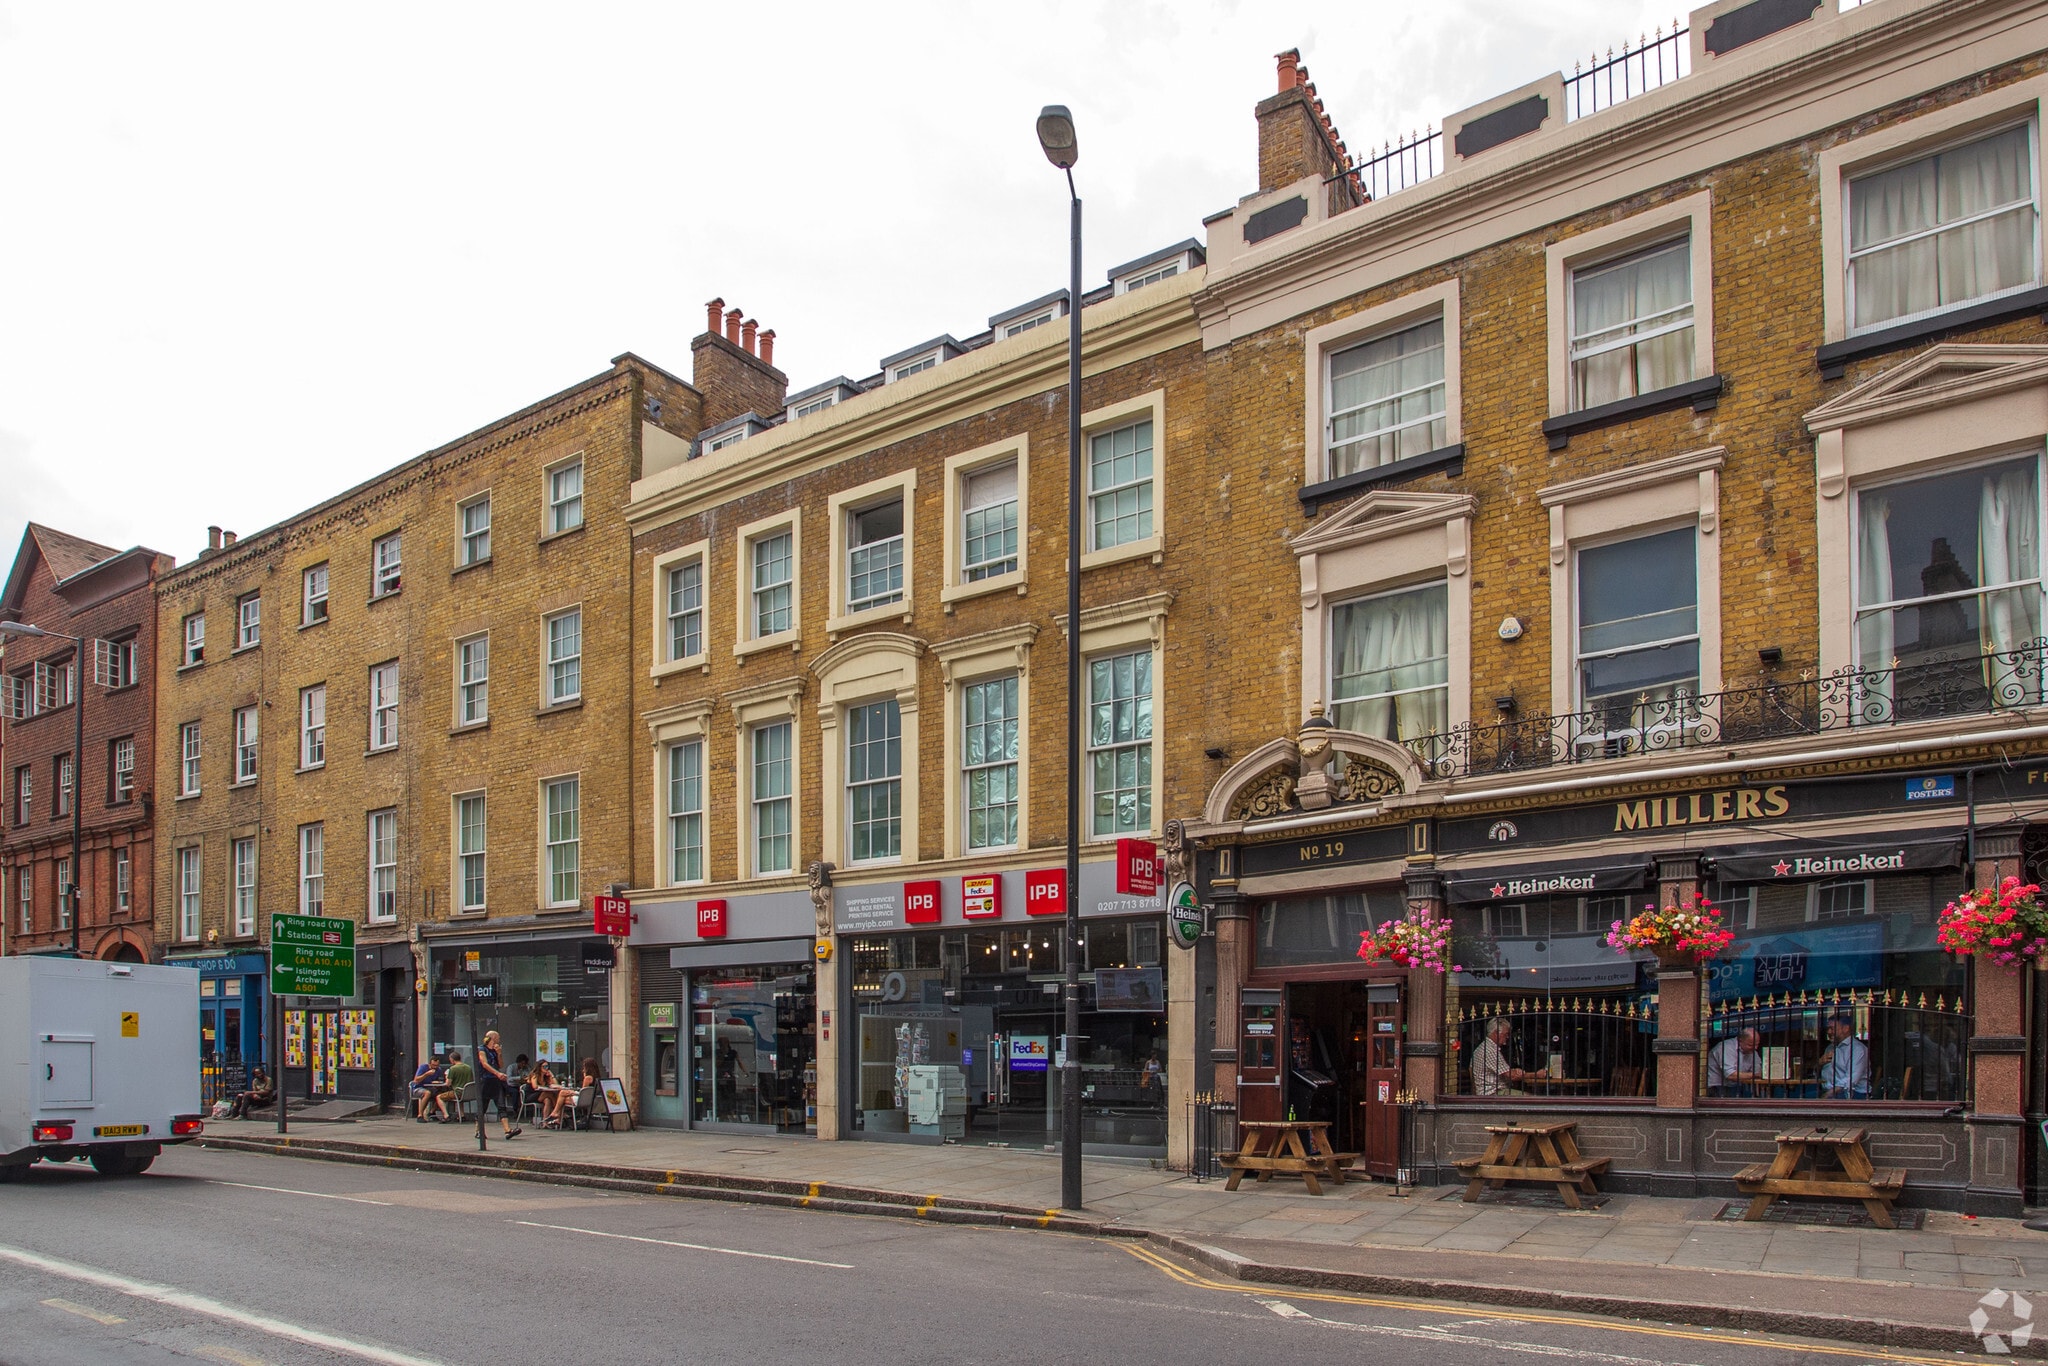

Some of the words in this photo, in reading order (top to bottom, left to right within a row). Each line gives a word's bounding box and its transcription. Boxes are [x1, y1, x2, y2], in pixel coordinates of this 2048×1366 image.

[1908, 788, 1952, 799] FOSTER'S
[1614, 786, 1789, 832] MILLERS
[1325, 842, 1344, 857] 19
[1131, 857, 1153, 878] IPB
[1794, 851, 1904, 874] Heineken
[1508, 874, 1595, 896] Heineken
[1030, 883, 1059, 901] IPB
[603, 899, 626, 914] IPB
[846, 898, 869, 906] SHIPPING
[870, 896, 895, 904] SERVICES
[908, 894, 934, 910] IPB
[1098, 901, 1119, 912] 0207
[1121, 900, 1137, 909] 713
[1139, 898, 1161, 908] 8718
[699, 909, 719, 923] IPB
[848, 911, 871, 919] PRINTING
[287, 918, 305, 927] Ring
[307, 920, 326, 928] road
[328, 921, 345, 930] (W)
[837, 919, 893, 930] www.myipb.com
[287, 931, 321, 940] Stations
[295, 948, 314, 956] Ring
[197, 959, 217, 971] SHOP
[224, 958, 236, 970] DO
[334, 959, 352, 968] A11)
[295, 967, 331, 976] Islington
[295, 976, 329, 985] Archway
[653, 1007, 670, 1016] CASH
[1013, 1041, 1045, 1054] FedEx
[104, 1127, 120, 1135] DA13
